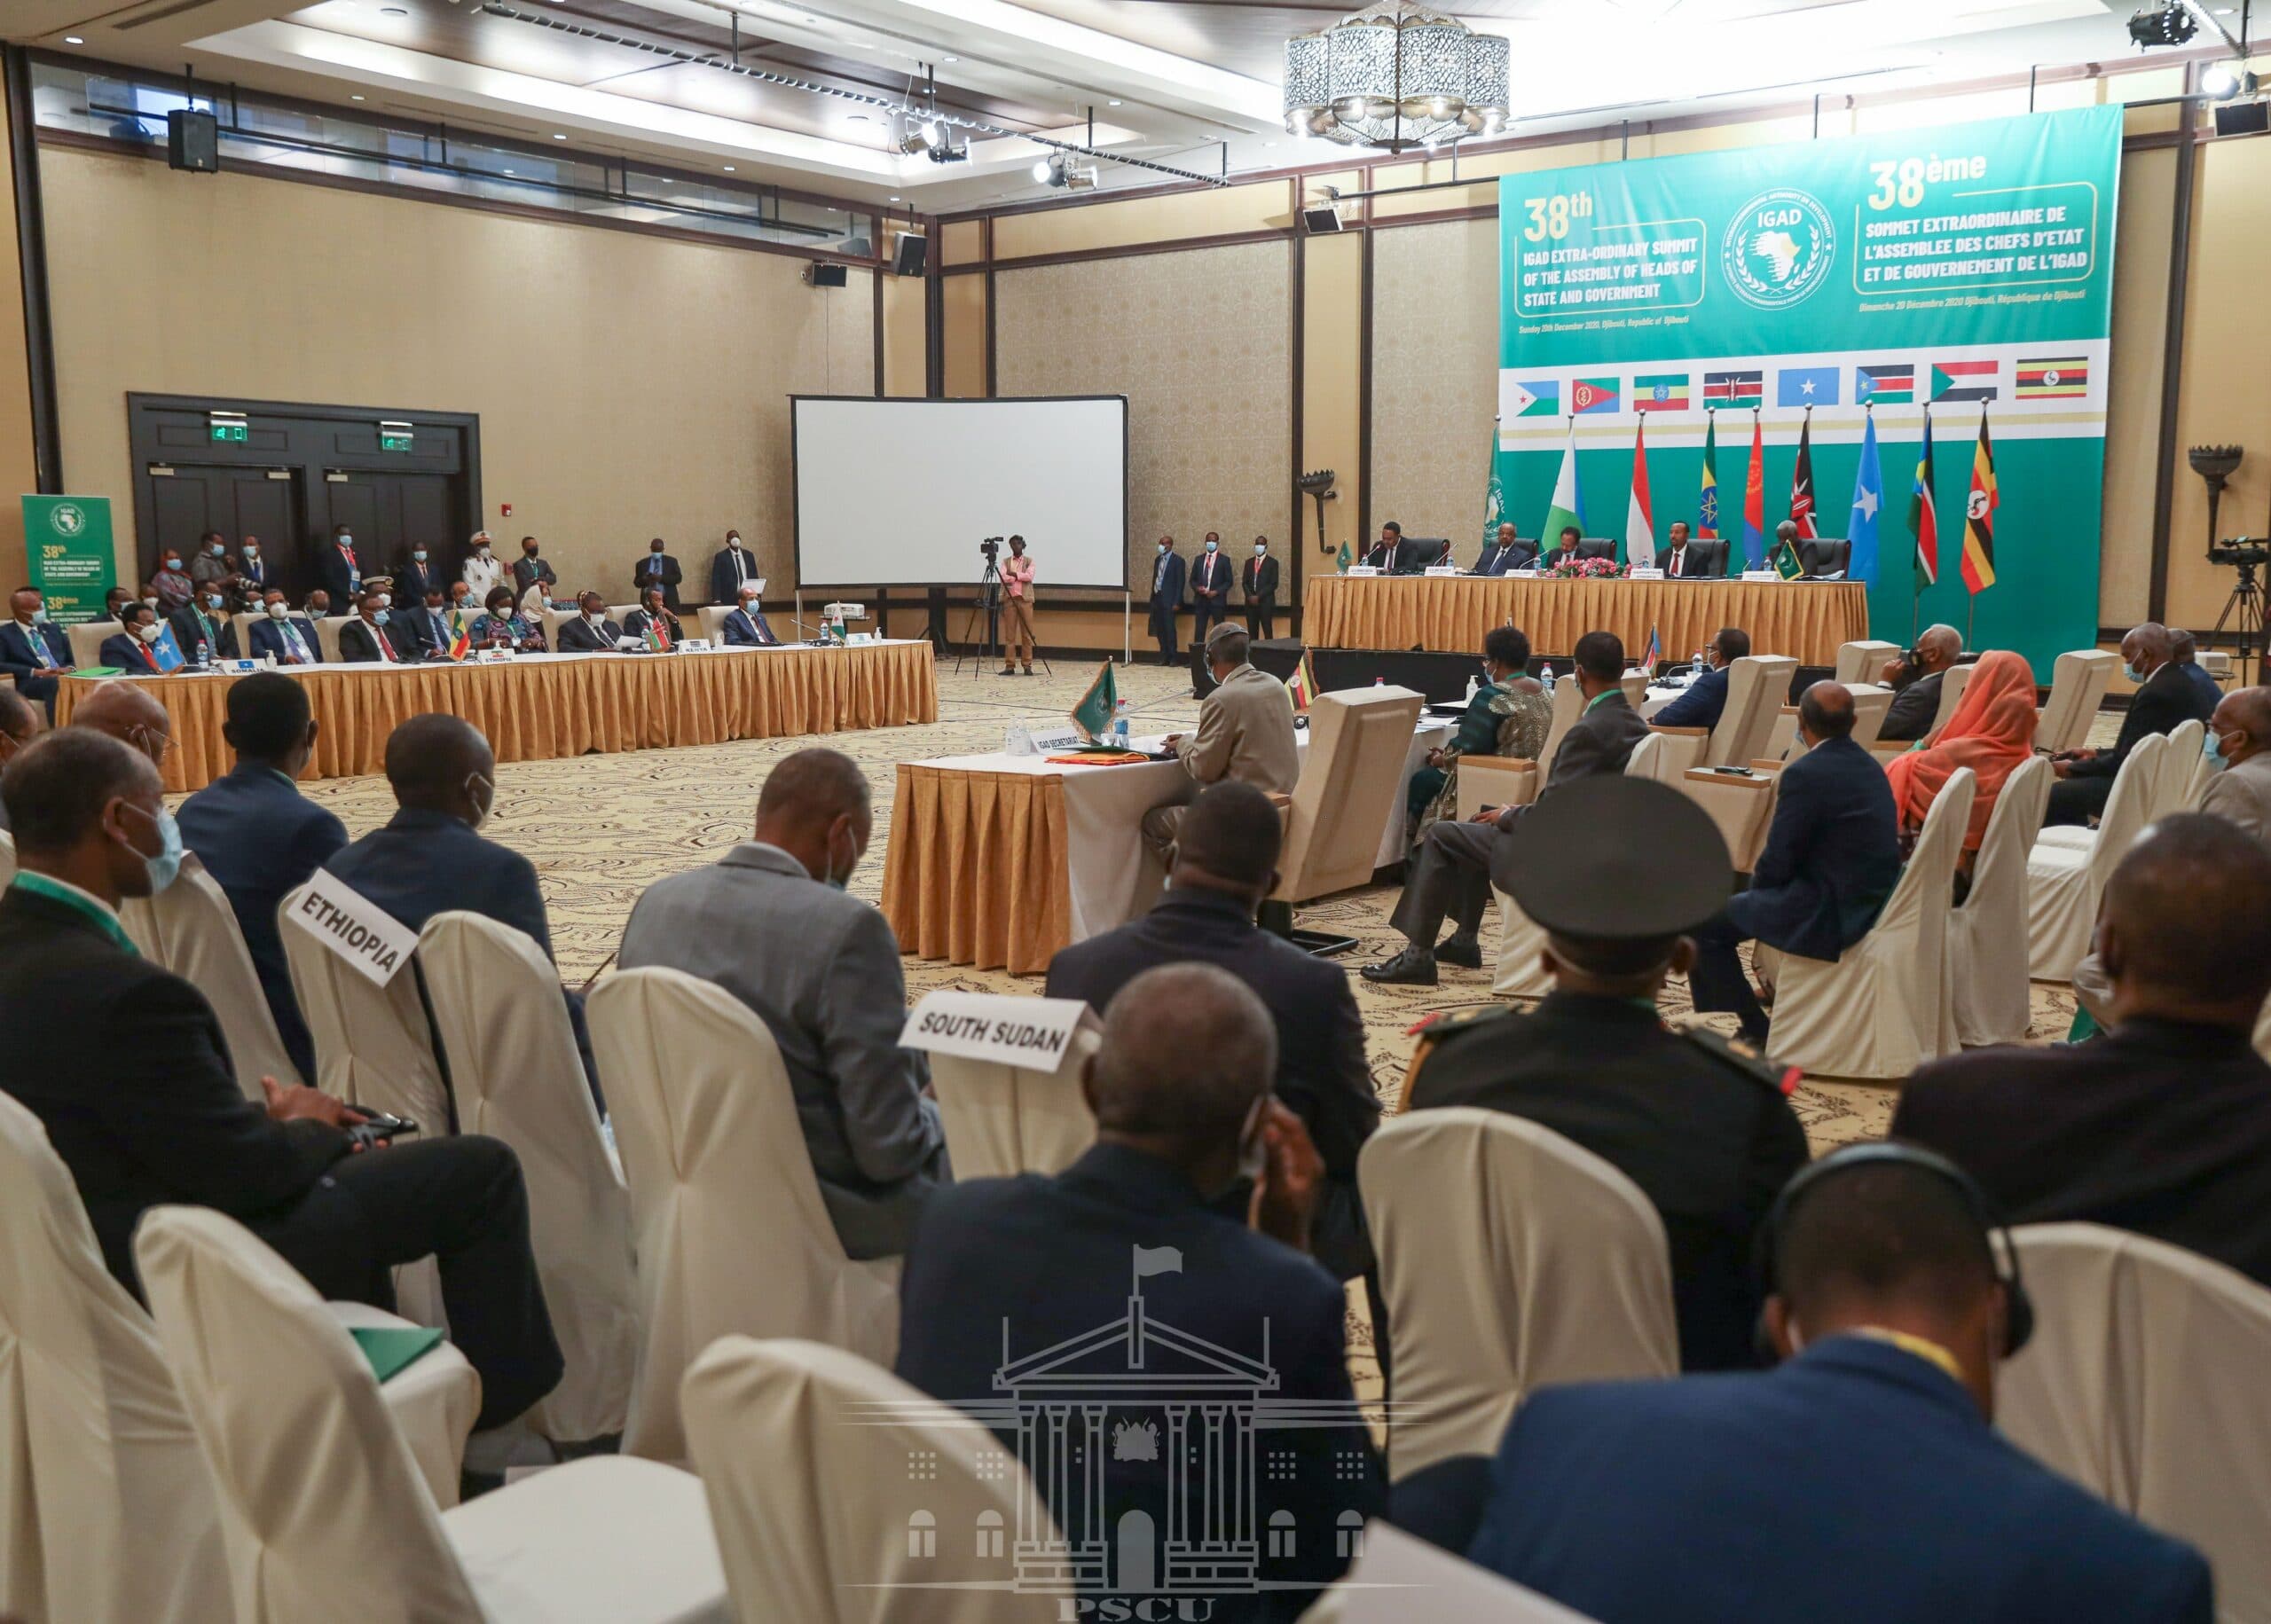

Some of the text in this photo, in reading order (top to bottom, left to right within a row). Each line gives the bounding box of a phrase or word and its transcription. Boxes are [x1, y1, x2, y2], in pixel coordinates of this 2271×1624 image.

[1867, 153, 1986, 211] 38ème
[1523, 191, 1592, 242] 38th
[1757, 208, 1802, 228] IGAD
[1866, 206, 2067, 238] SOMMET EXTRAORDINAIRE DE
[1523, 238, 1698, 266] IGAD EXTRA-ORDINARY SUMMIT
[1865, 228, 2085, 261] L'ASSEMBLEE DES CHEFS D'ETAT
[1523, 259, 1698, 286] OF THE ASSEMBLY OF HEADS OF
[1863, 252, 2087, 283] ET DE GOUVERNEMENT DE L'IGAD
[1523, 283, 1662, 308] STATE AND GOVERNMENT
[1945, 297, 1963, 307] 2020
[2042, 291, 2053, 300] de
[1519, 325, 1541, 335] Sunday
[1554, 322, 1584, 332] December
[1628, 317, 1654, 328] Republic
[1655, 317, 1662, 326] of
[1037, 736, 1079, 749] IGAD SECRETARIAT
[301, 890, 399, 973] ETHIOPIA
[919, 1011, 1066, 1053] SOUTH SUDAN
